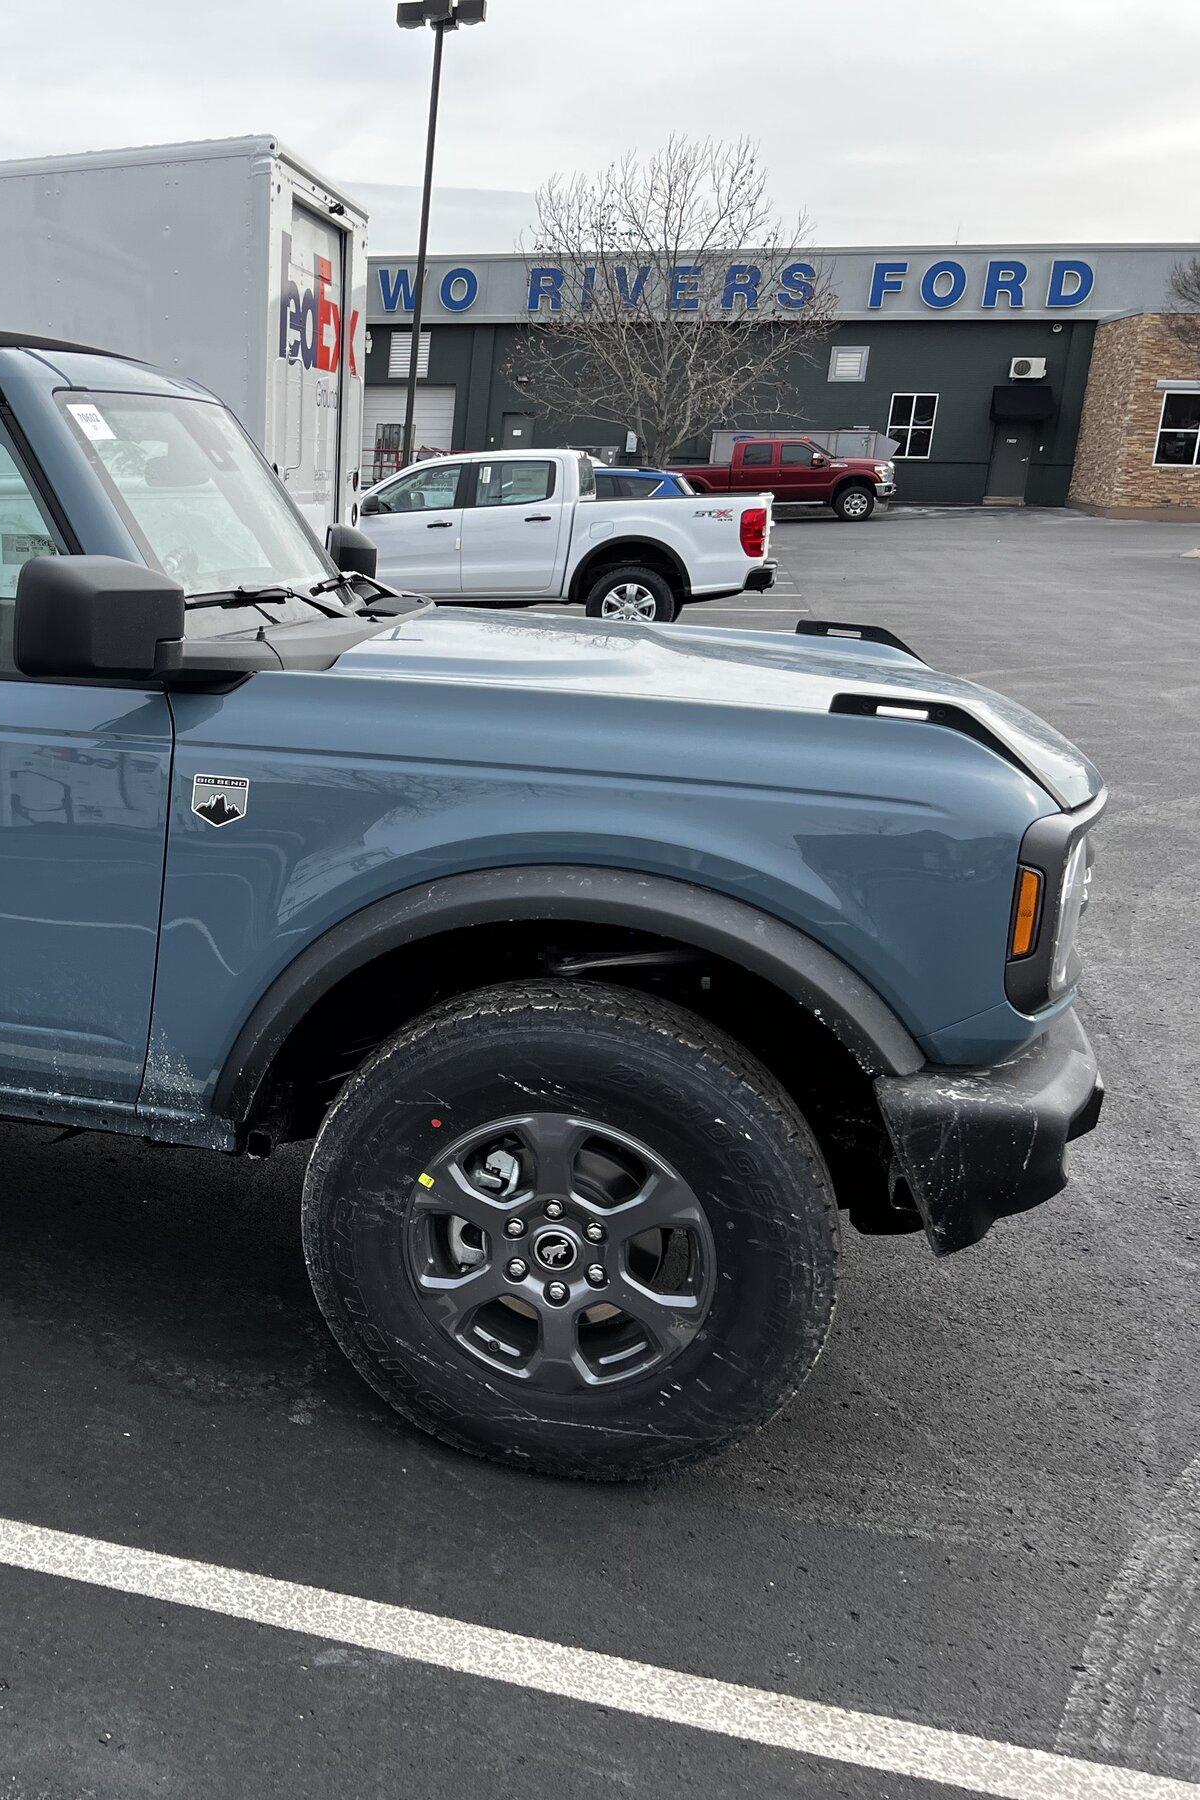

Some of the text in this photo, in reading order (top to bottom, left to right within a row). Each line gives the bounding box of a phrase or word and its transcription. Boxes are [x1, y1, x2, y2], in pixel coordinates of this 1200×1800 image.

[526, 261, 818, 312] RIVERS
[867, 259, 1096, 309] FORD
[693, 508, 733, 518] STX
